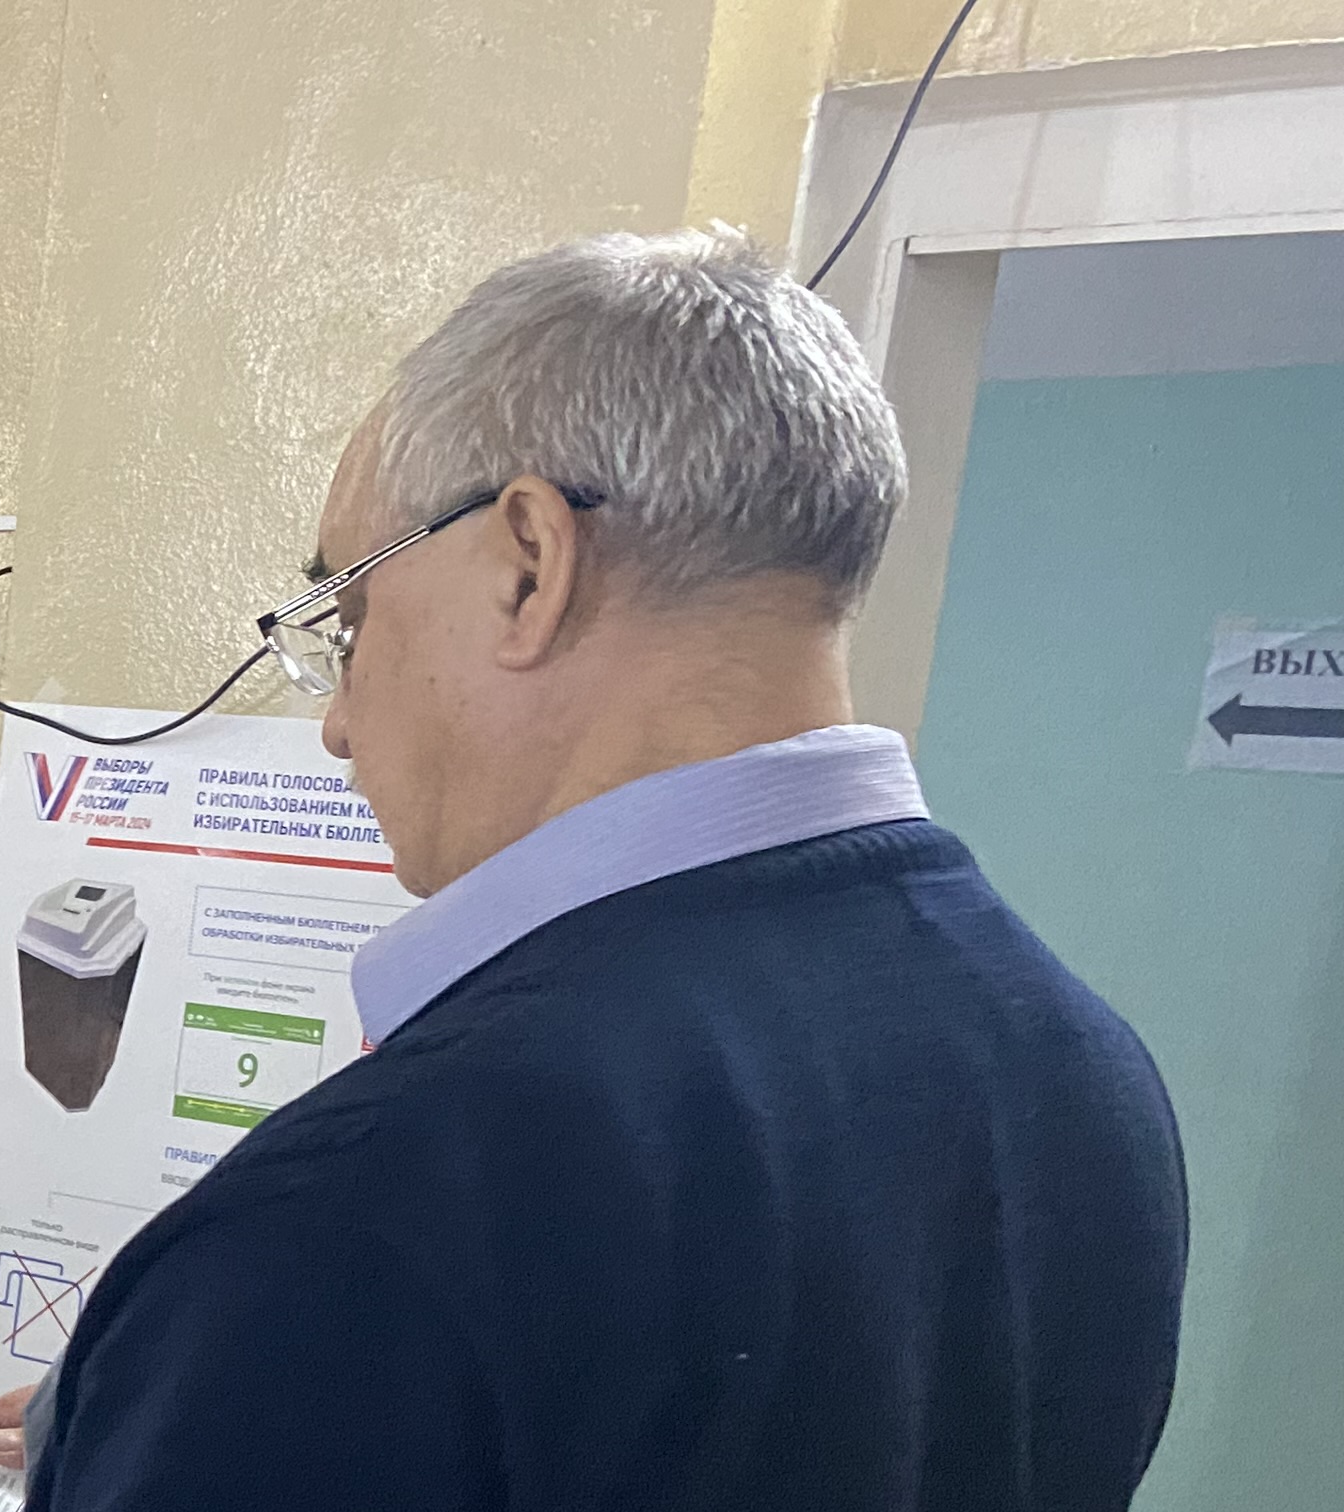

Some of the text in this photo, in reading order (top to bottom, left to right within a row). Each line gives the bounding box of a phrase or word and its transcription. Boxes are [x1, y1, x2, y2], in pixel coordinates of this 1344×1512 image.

[93, 758, 154, 774] ВЫБОРЫ
[199, 768, 269, 788] ПРАВИЛА
[23, 752, 89, 821] V
[84, 776, 170, 796] ПРЕЗИДЕНТА
[75, 794, 129, 811] РОССИИ
[197, 791, 206, 806] С
[210, 792, 353, 818] ИСПОЛЬЗОВАНИЕМ
[94, 814, 127, 829] МАРТА
[127, 817, 152, 830] 2024
[193, 814, 323, 839] ИЗБИРАТЕЛЬНЫХ
[204, 907, 212, 917] С
[213, 908, 296, 926] ЗАПОЛНЕННЫМ
[297, 918, 370, 934] БЮЛЛЕТЕНЕМ
[201, 927, 263, 942] ОБРАБОТКИ
[265, 934, 355, 953] ИЗБИРАТЕЛЬНЫХ
[238, 1053, 258, 1088] 9
